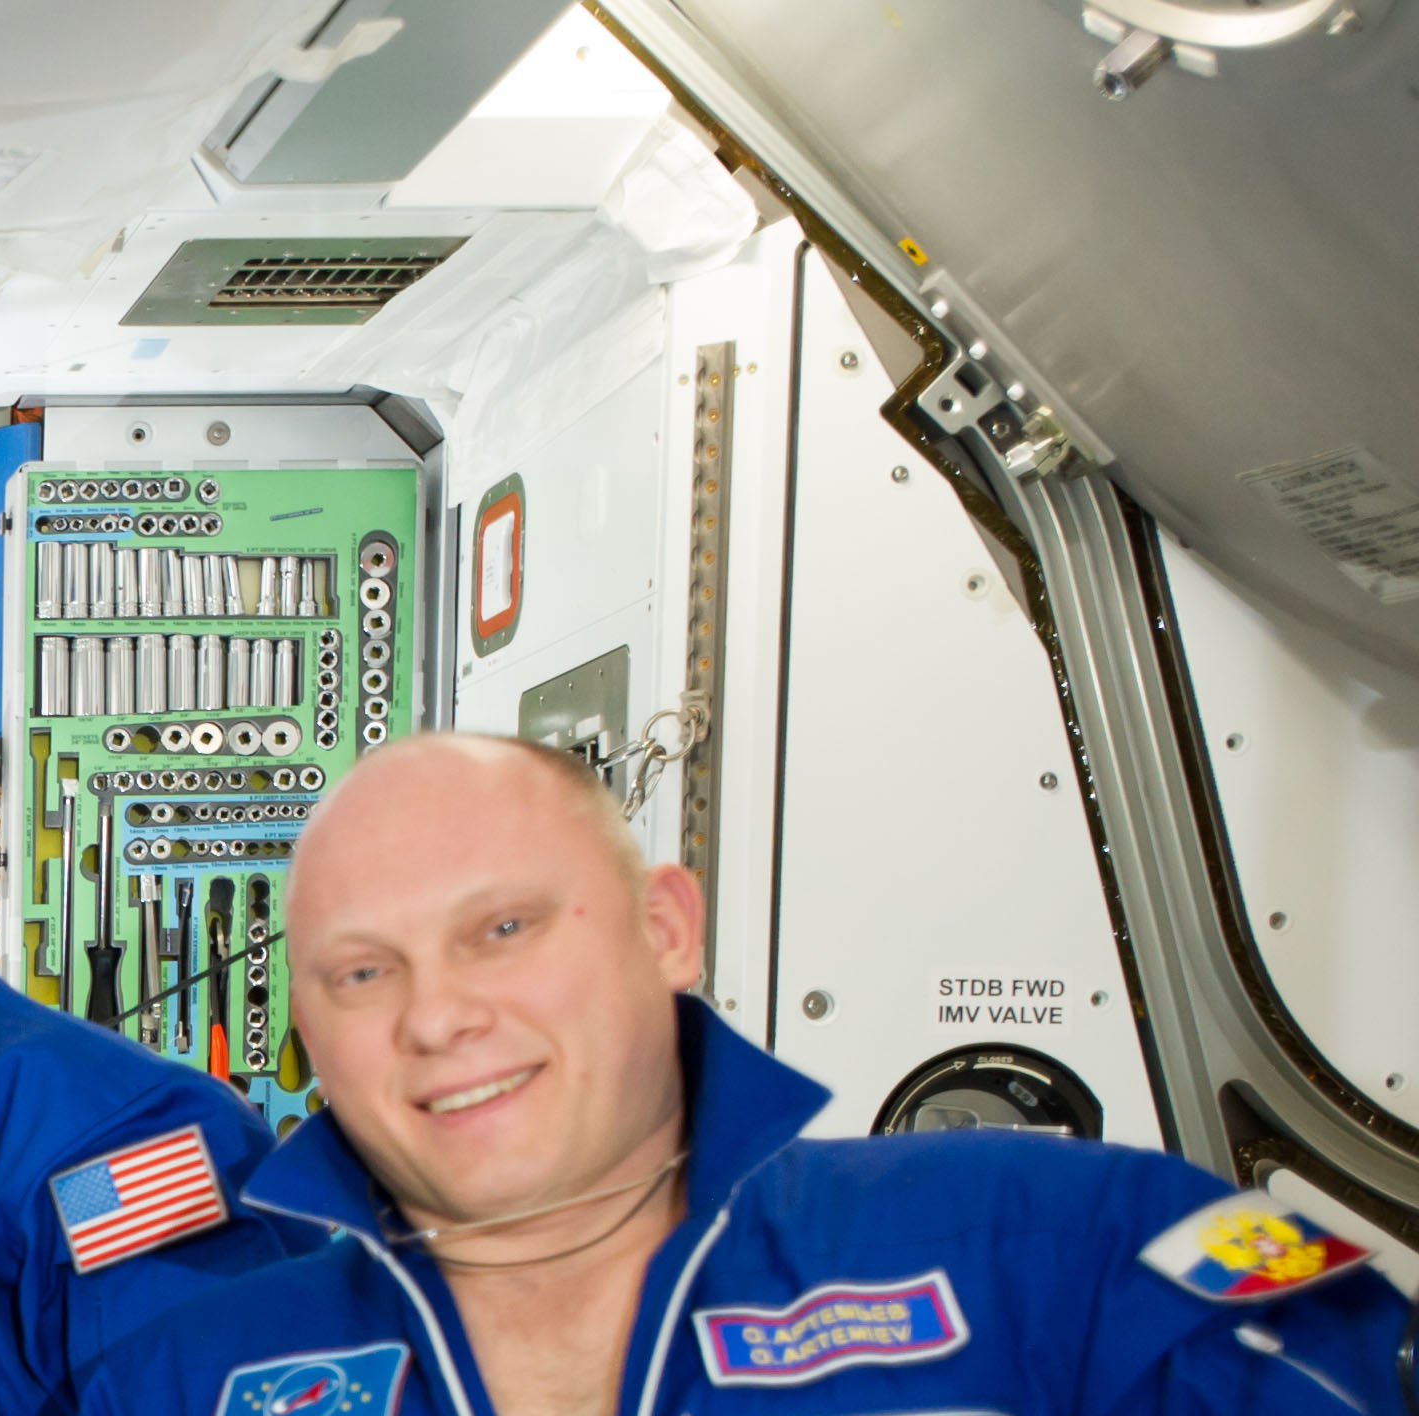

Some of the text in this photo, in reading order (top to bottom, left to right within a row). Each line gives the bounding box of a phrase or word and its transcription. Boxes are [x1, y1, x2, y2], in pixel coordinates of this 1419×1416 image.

[939, 978, 1066, 998] STDB FWD
[938, 1005, 1063, 1024] IMV VALVE
